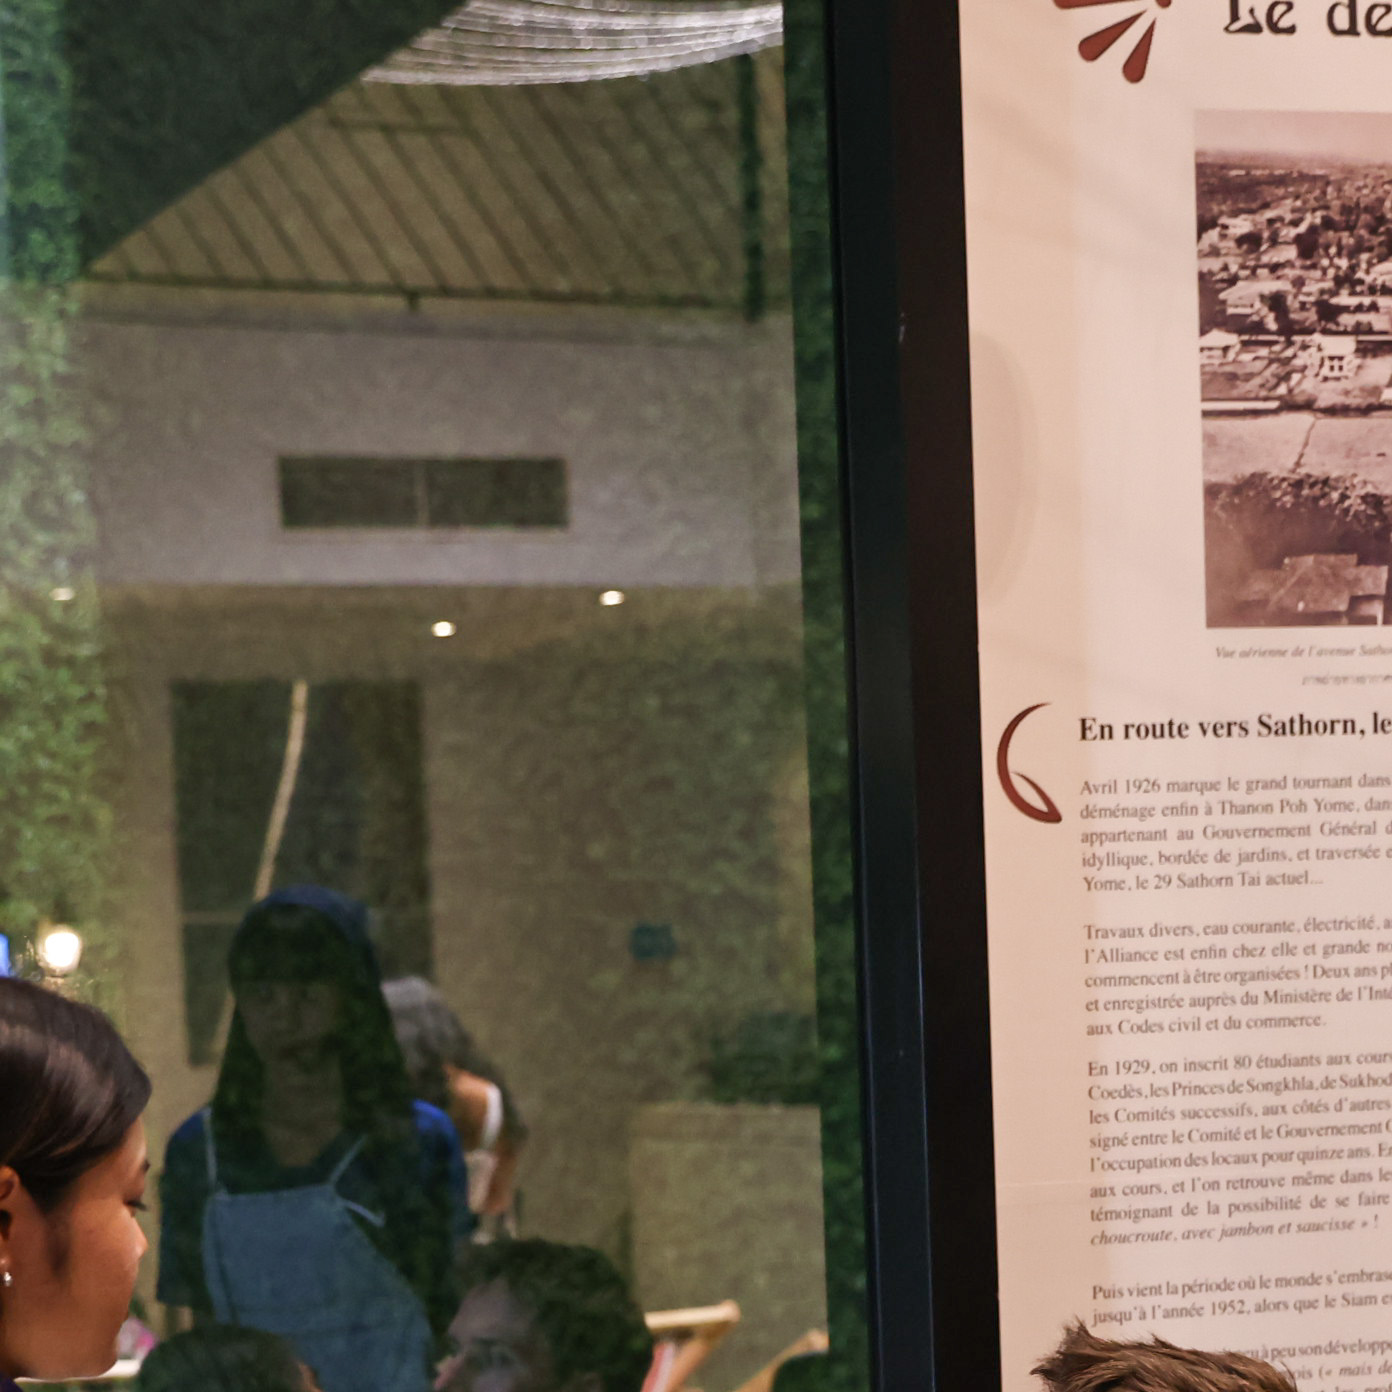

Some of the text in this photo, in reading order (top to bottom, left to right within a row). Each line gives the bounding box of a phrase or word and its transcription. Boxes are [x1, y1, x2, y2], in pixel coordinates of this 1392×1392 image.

[1223, 0, 1297, 35] Le
[1079, 717, 1114, 742] En
[1123, 719, 1190, 741] route
[1198, 721, 1250, 739] vers
[1372, 712, 1392, 736] le
[1080, 778, 1118, 794] Avril
[1125, 777, 1161, 793] 1926
[1166, 780, 1222, 796] marque
[1227, 776, 1240, 791] le
[1245, 775, 1288, 794] grand
[1292, 775, 1353, 789] tournant
[1357, 772, 1392, 788] dans
[1079, 802, 1156, 823] déménage
[1160, 801, 1199, 817] enfin
[1204, 801, 1213, 816] à
[1218, 799, 1275, 815] Thanon
[1279, 798, 1308, 814] Poh
[1080, 828, 1168, 846] appartenant
[1176, 829, 1195, 840] au
[1202, 822, 1312, 839] Gouvernement
[1319, 820, 1378, 836] Général
[1157, 848, 1209, 864] bordée
[1213, 847, 1232, 863] de
[1296, 847, 1311, 860] et
[1315, 843, 1381, 860] traversée
[1135, 875, 1149, 890] le
[1153, 874, 1173, 889] 29
[1176, 873, 1234, 889] Sathorn
[1240, 872, 1261, 888] Tai
[1084, 922, 1145, 939] Travaux
[1202, 924, 1229, 935] eau
[1084, 946, 1159, 963] l'Alliance
[1163, 947, 1185, 960] est
[1189, 943, 1228, 959] enfin
[1232, 942, 1267, 958] chez
[1270, 941, 1298, 957] elle
[1302, 943, 1317, 956] et
[1321, 939, 1371, 959] grande
[1086, 1023, 1113, 1035] aux
[1117, 1017, 1165, 1034] Codes
[1167, 1016, 1202, 1032] civil
[1204, 1018, 1220, 1031] et
[1222, 1015, 1243, 1030] du
[1088, 1060, 1109, 1076] En
[1158, 1061, 1179, 1073] on
[1183, 1058, 1229, 1072] inscrit
[1233, 1054, 1253, 1070] 80
[1255, 1052, 1322, 1069] étudiants
[1325, 1054, 1352, 1066] aux
[1181, 1227, 1216, 1240] avec
[1218, 1220, 1275, 1242] jambon
[1277, 1221, 1293, 1235] et
[1295, 1218, 1356, 1234] saucisse
[1093, 1304, 1148, 1326] jusqu'à
[1151, 1301, 1205, 1318] l'année
[1253, 1296, 1290, 1313] alors
[1292, 1298, 1320, 1314] que
[1324, 1293, 1337, 1308] le
[1340, 1291, 1379, 1307] Siam
